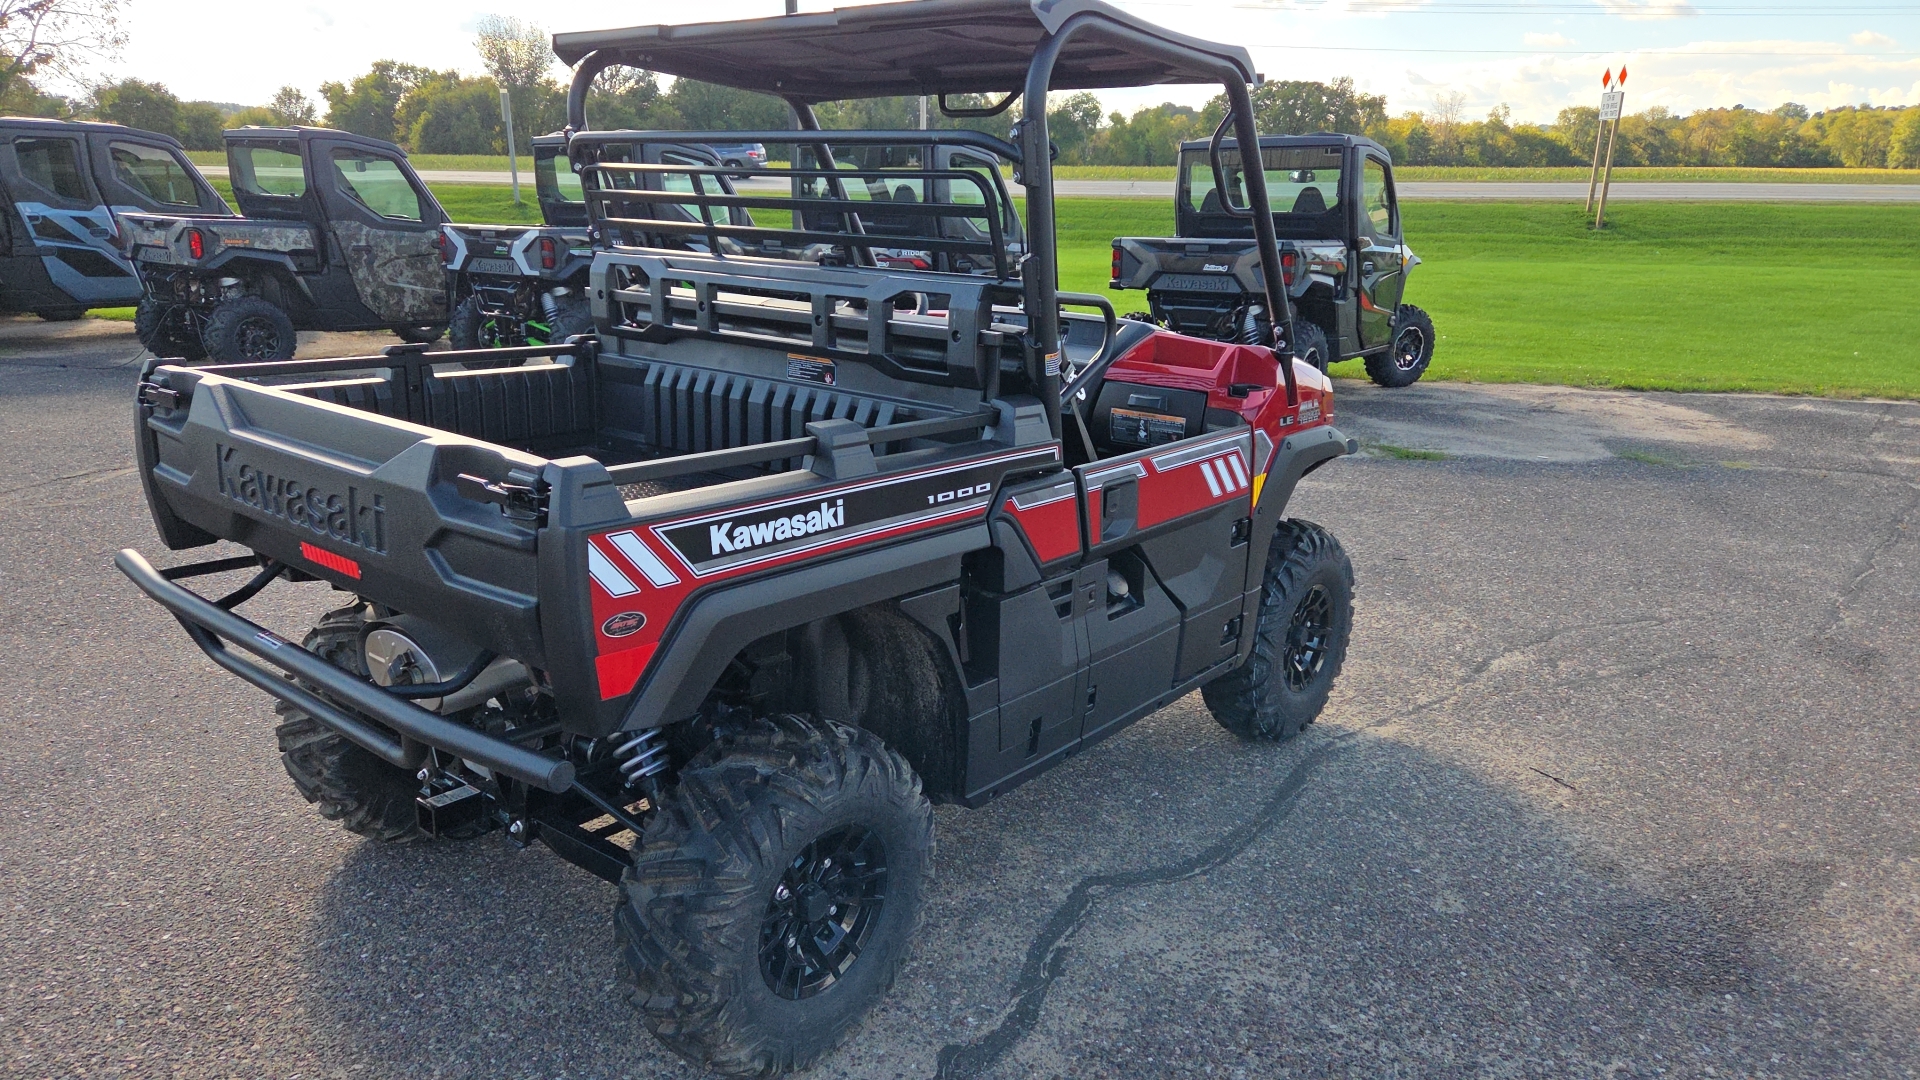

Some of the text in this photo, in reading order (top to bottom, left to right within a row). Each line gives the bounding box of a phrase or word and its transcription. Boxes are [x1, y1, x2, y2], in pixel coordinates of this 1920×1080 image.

[475, 259, 514, 274] Kawasaki
[1165, 274, 1229, 290] Kawasaki
[1280, 415, 1294, 427] LE
[216, 443, 388, 556] Kawasaki
[927, 482, 991, 504] 1000
[709, 498, 845, 556] Kawasaki
